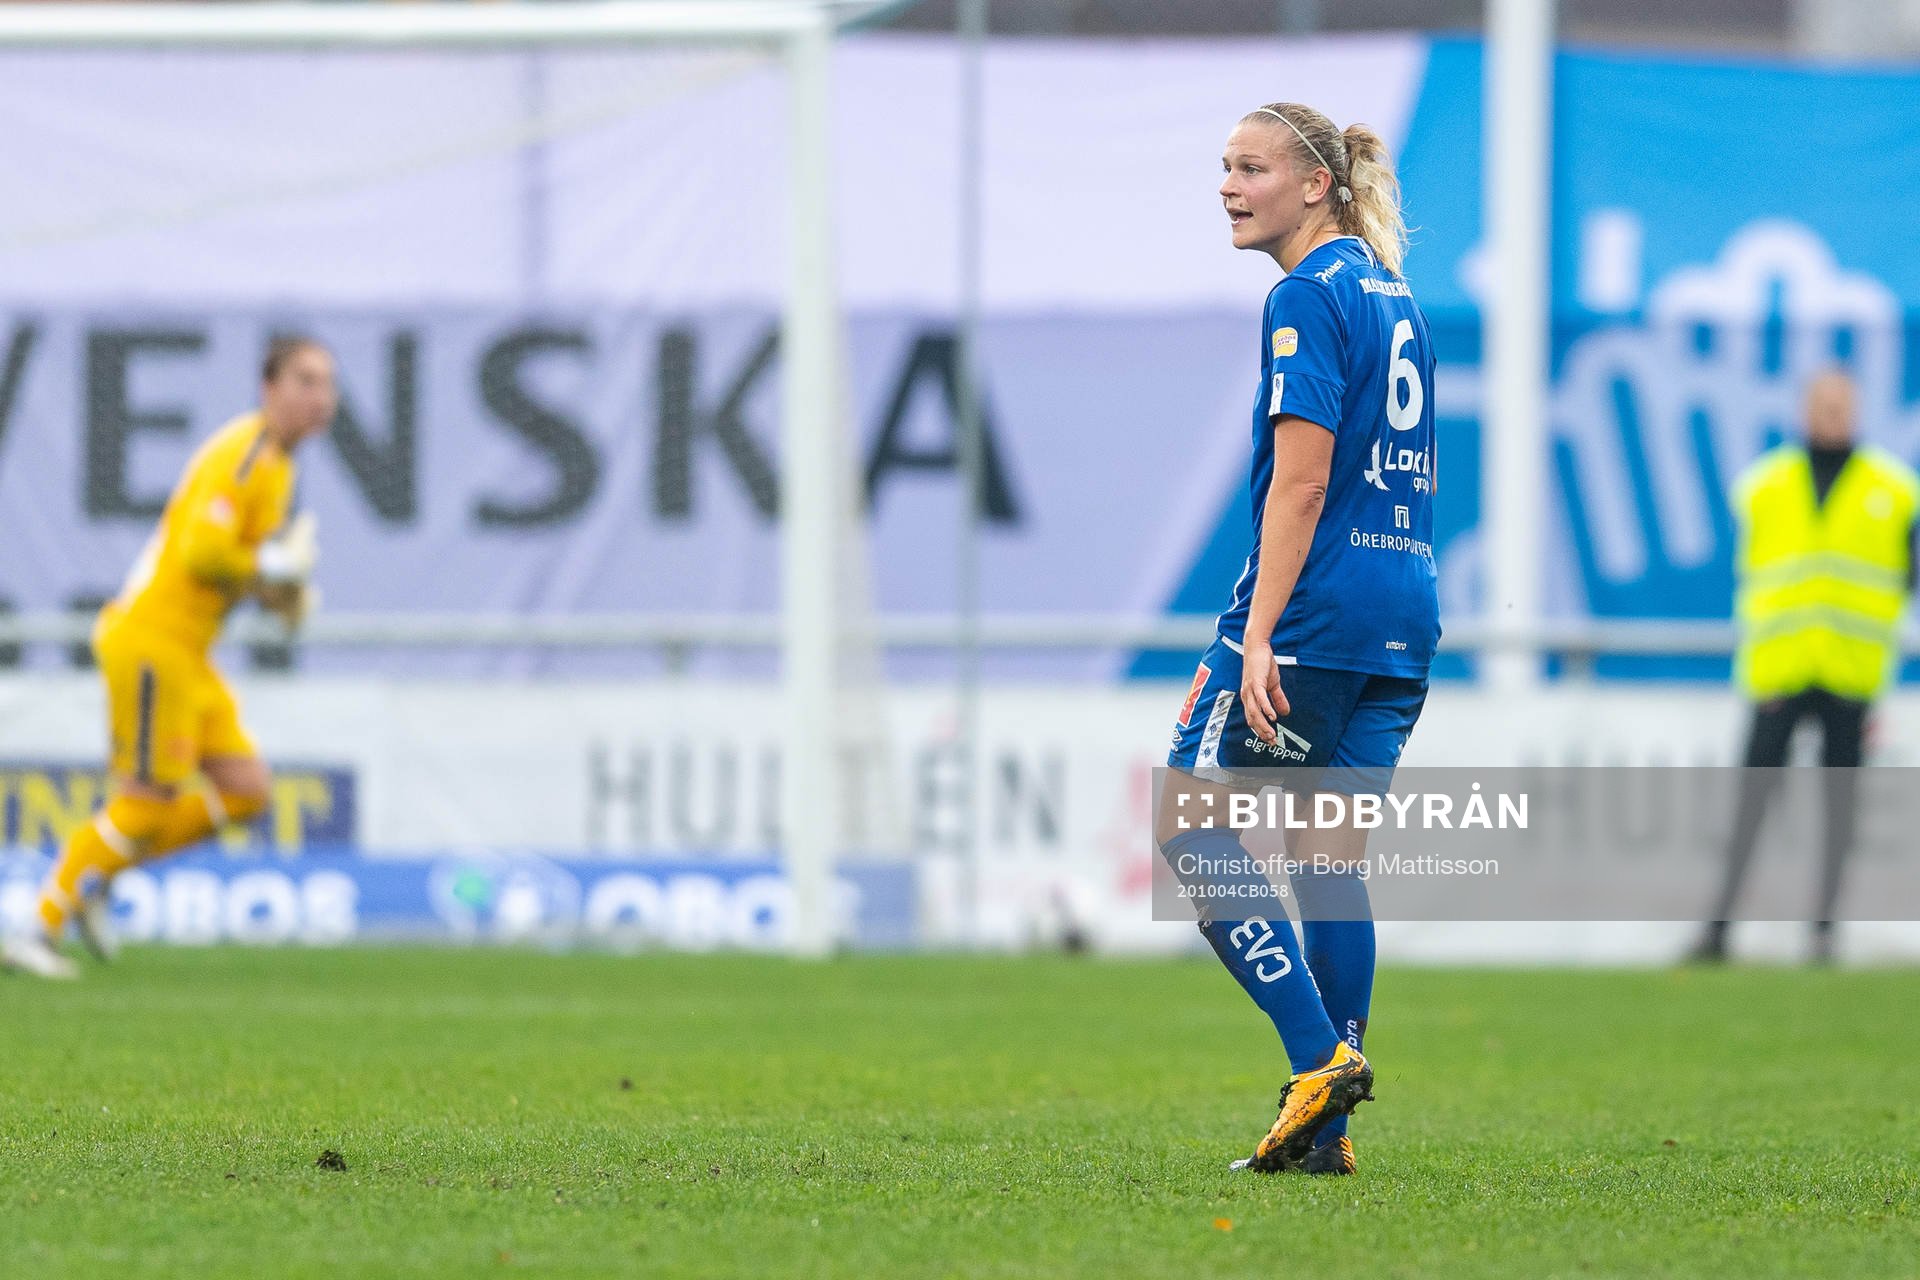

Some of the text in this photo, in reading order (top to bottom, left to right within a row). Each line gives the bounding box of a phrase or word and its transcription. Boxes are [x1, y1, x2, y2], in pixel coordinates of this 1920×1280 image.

[1386, 319, 1424, 431] 6
[1350, 527, 1434, 559] ÖREBROPORTEN
[1244, 736, 1306, 762] elgruppen
